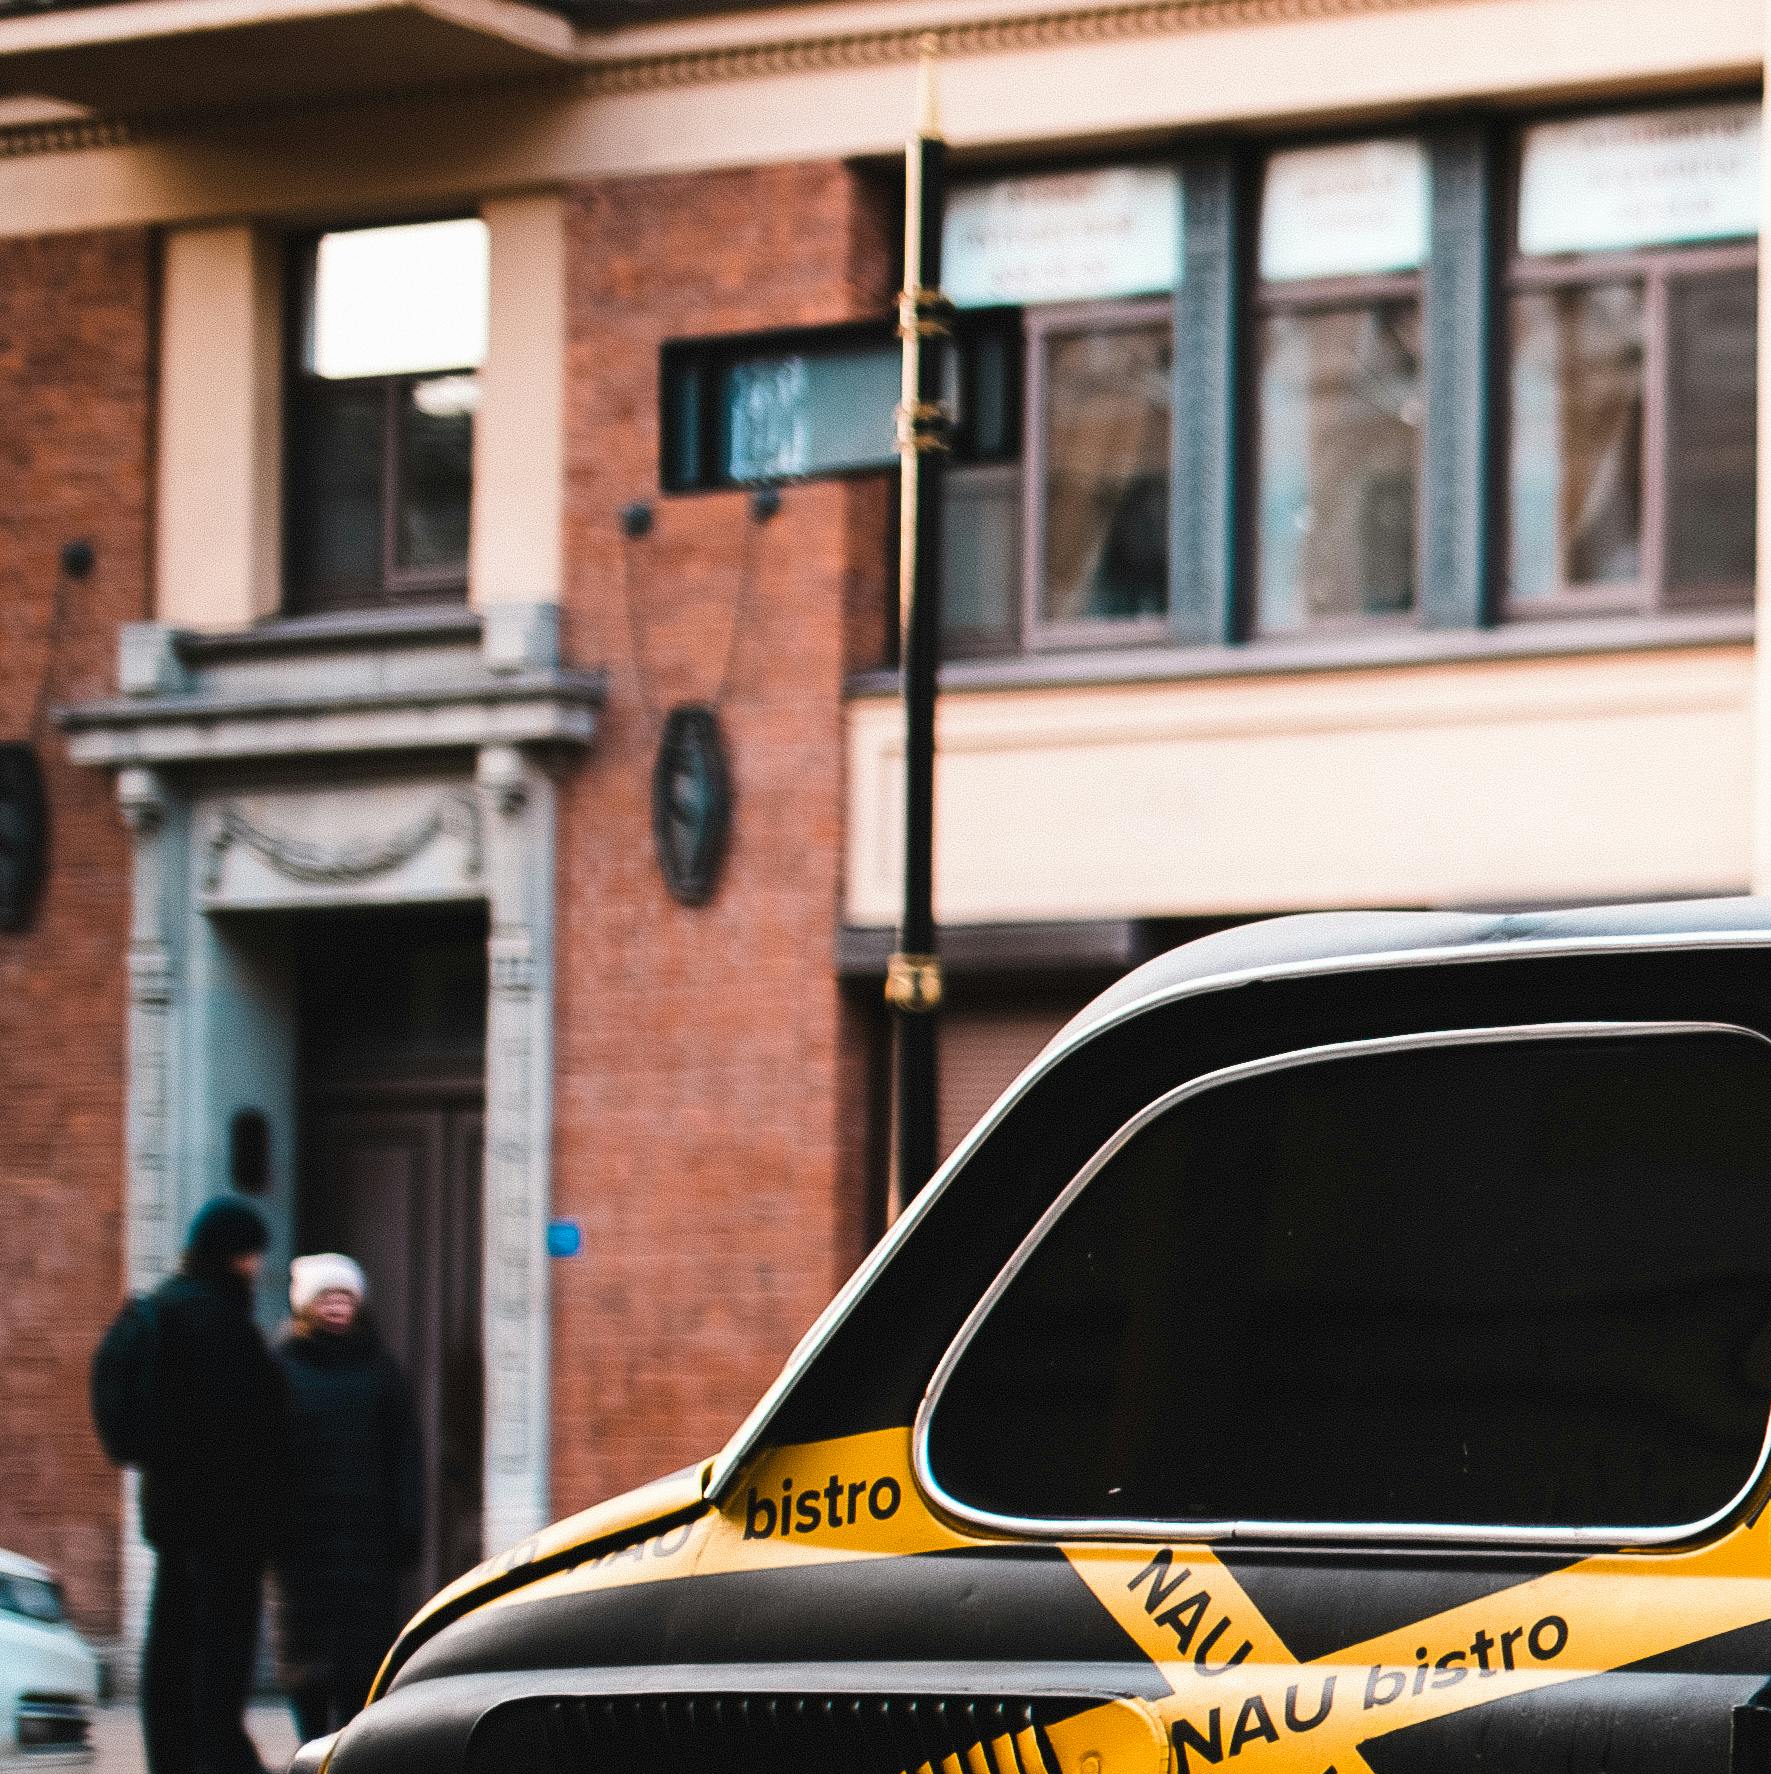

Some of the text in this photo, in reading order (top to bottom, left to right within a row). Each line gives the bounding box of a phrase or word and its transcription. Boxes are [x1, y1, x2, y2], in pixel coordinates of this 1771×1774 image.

[743, 1475, 901, 1541] bistro
[1127, 1548, 1253, 1677] NAU
[1363, 1614, 1569, 1712] bistro
